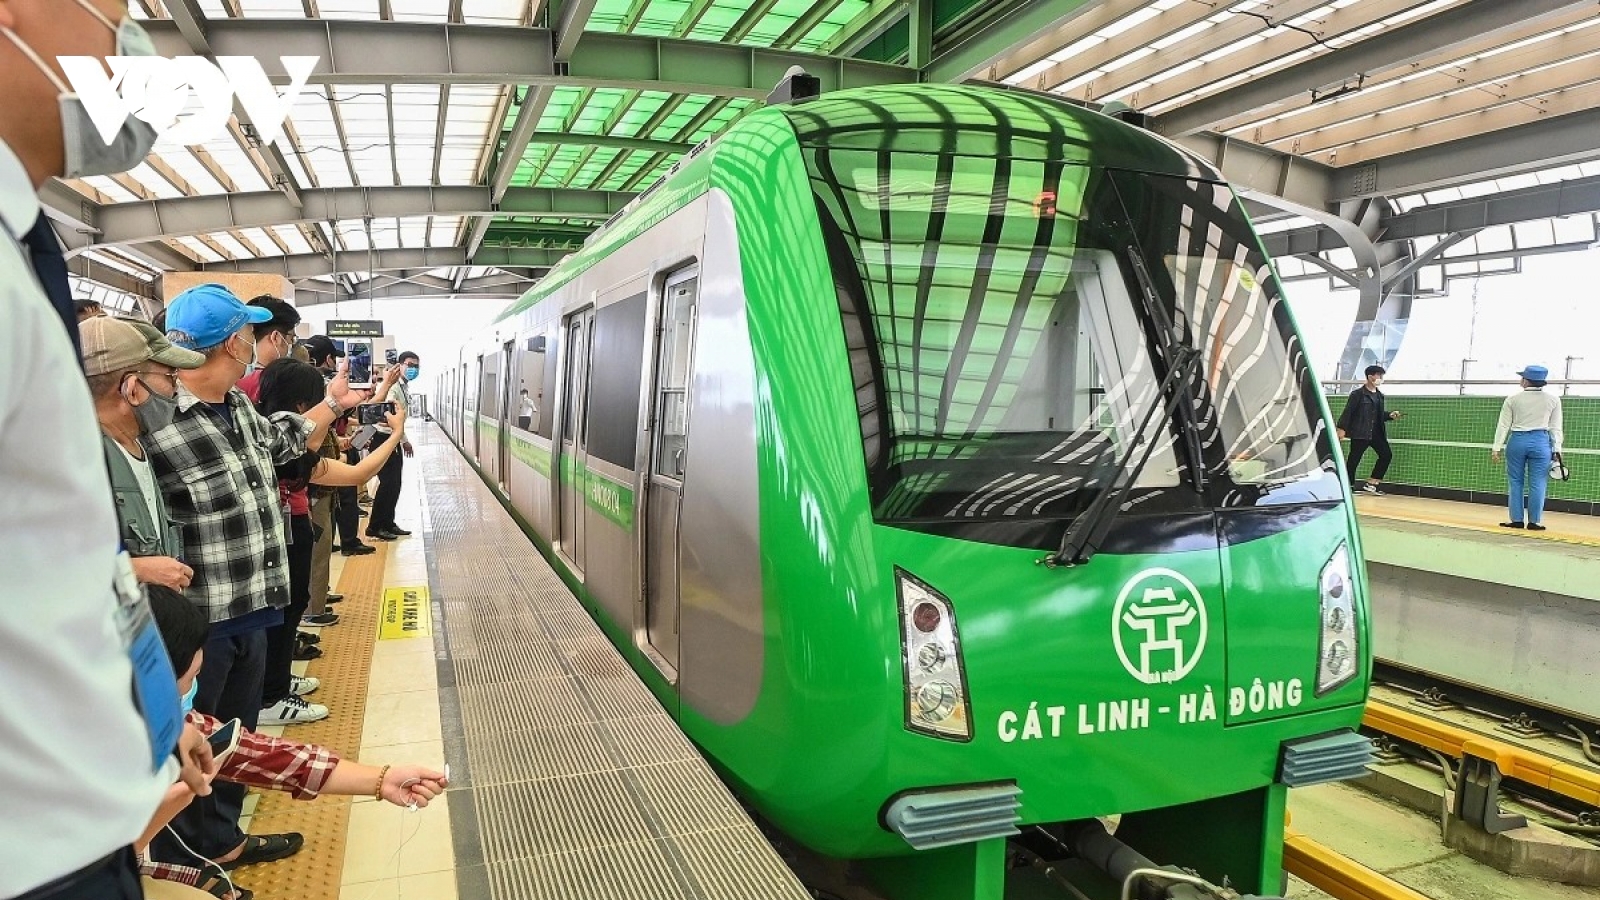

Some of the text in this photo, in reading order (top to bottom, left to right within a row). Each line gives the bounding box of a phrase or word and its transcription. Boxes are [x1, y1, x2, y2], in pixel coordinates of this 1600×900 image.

[997, 702, 1066, 743] CÁT
[1078, 698, 1149, 735] LINH
[1179, 685, 1217, 724] HÀ
[1229, 677, 1302, 716] ĐÔNG
